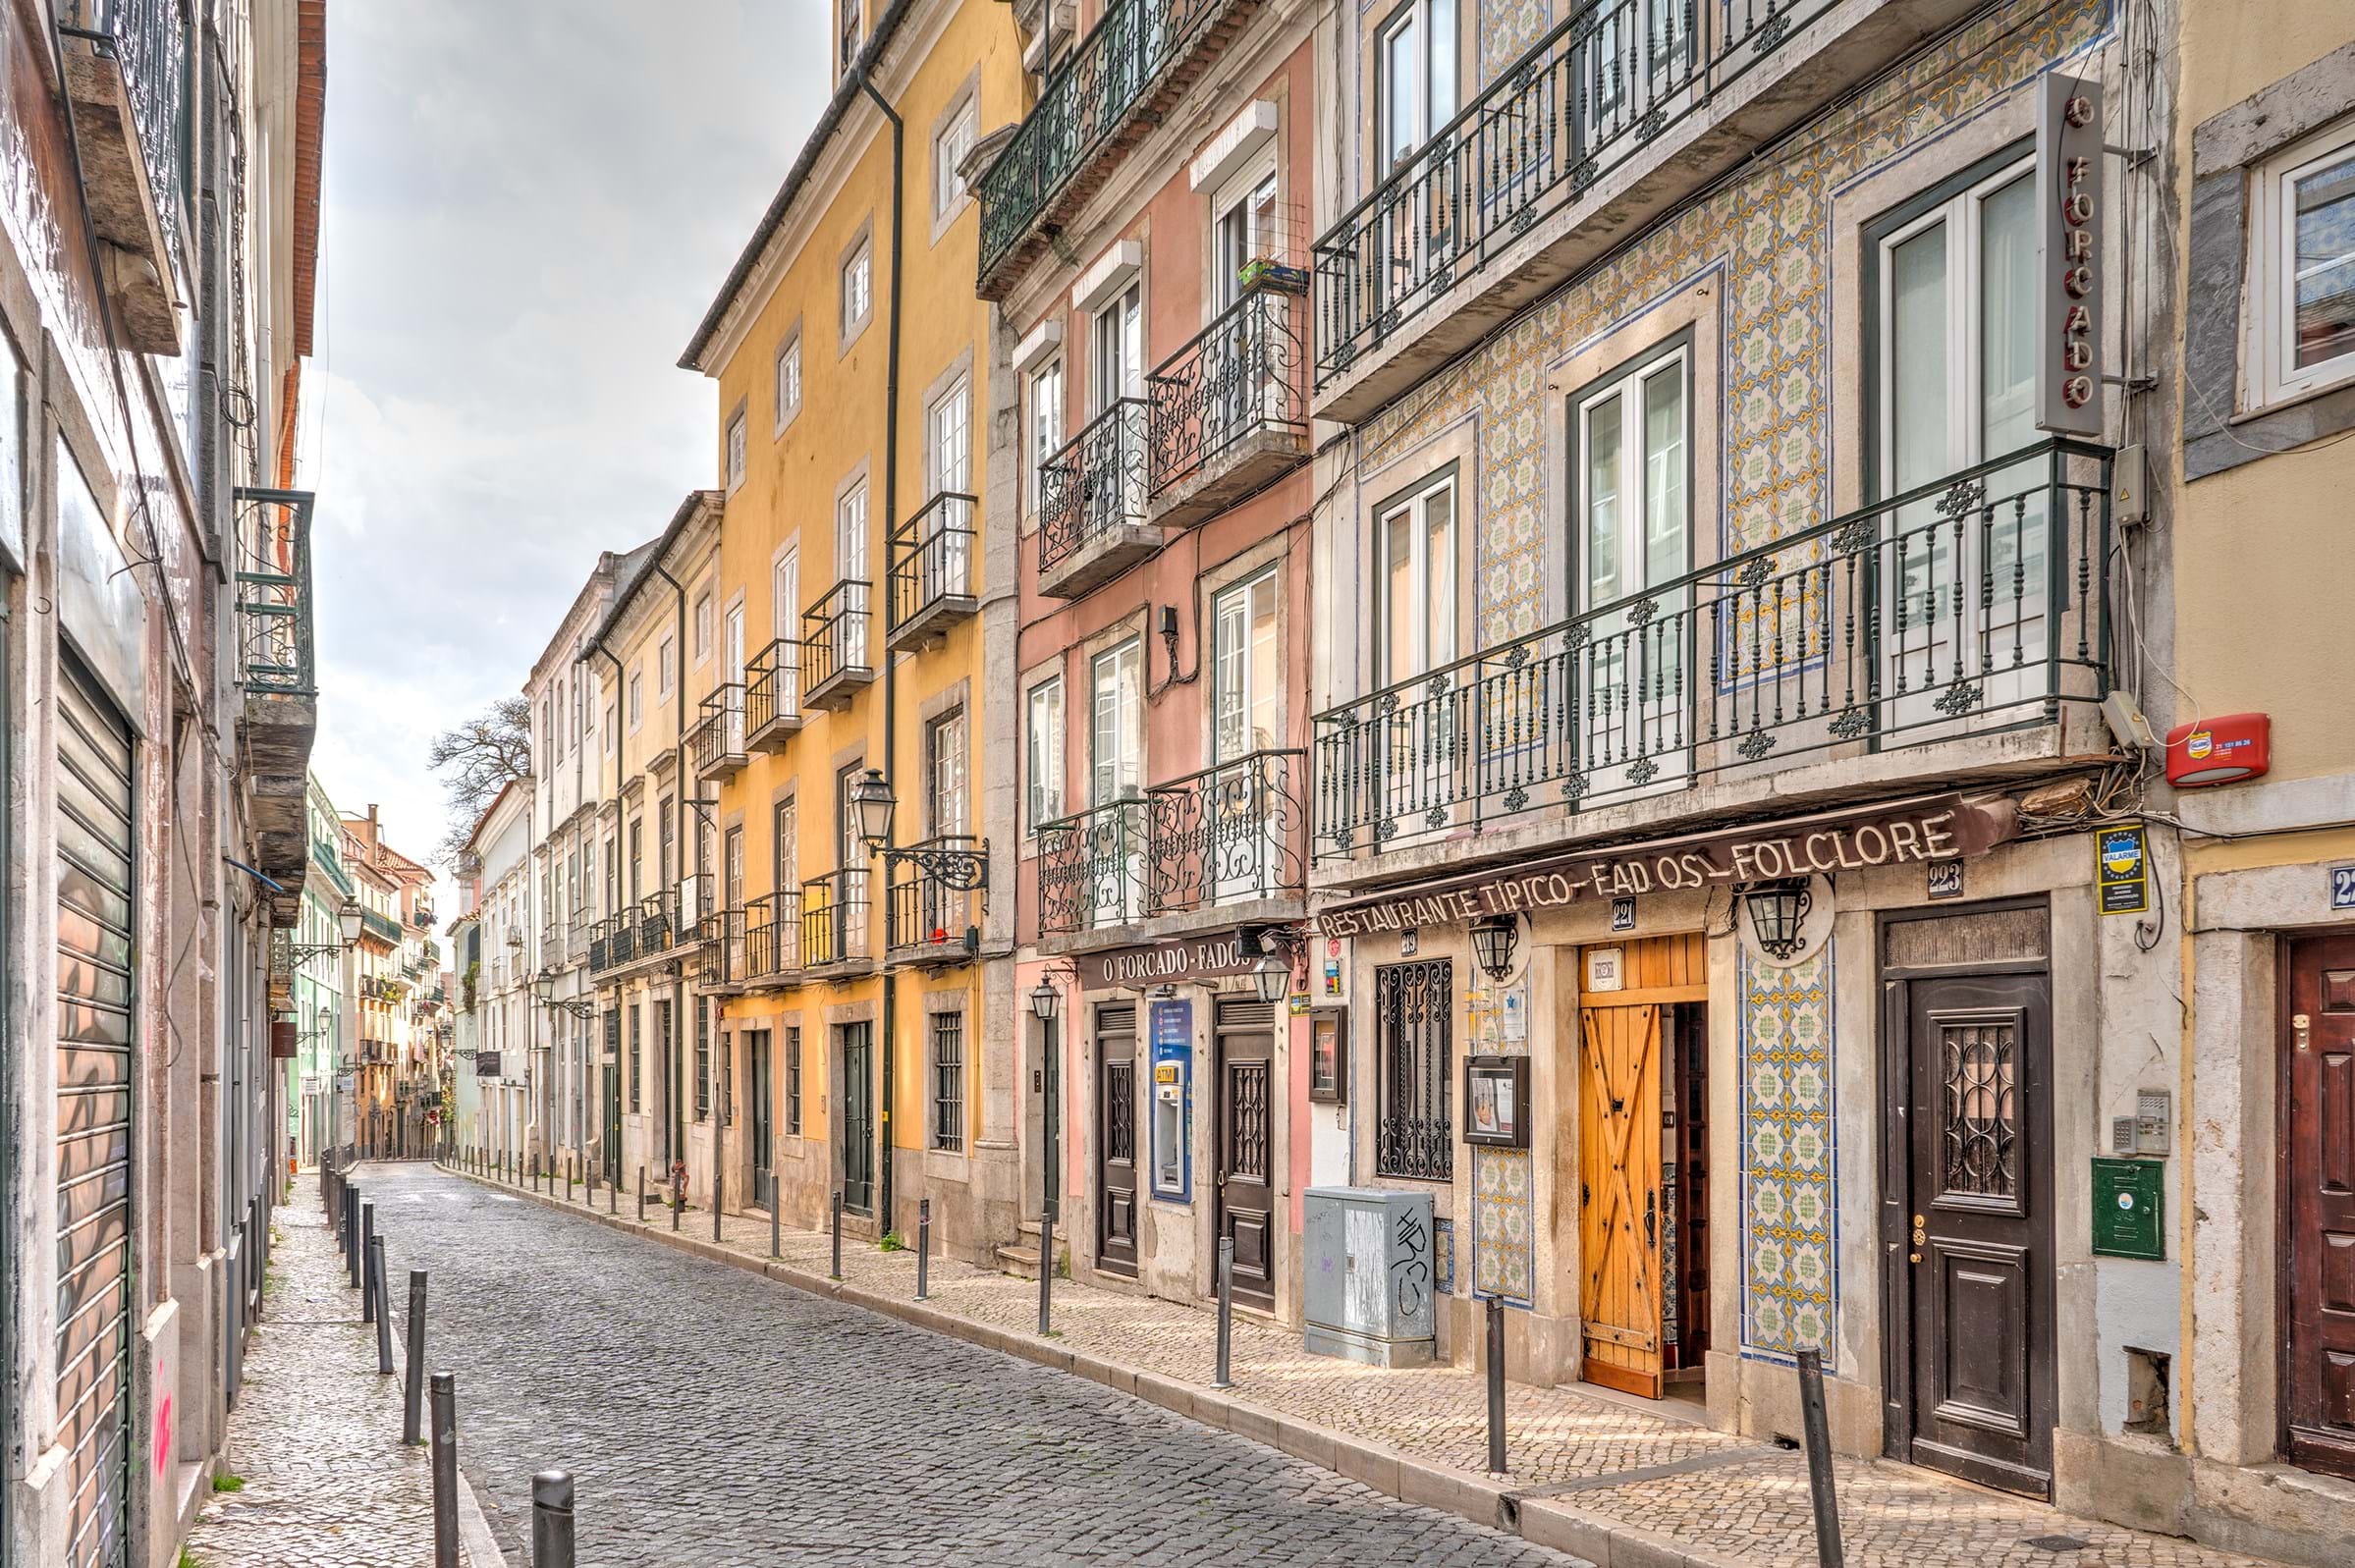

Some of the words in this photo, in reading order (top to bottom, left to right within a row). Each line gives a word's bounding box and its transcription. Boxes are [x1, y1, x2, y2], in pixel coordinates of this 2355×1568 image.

[2064, 96, 2095, 129] O
[2063, 156, 2095, 409] FORCADO
[2104, 849, 2139, 862] VALARME
[1320, 889, 1484, 939] RESTAURANTE
[1731, 809, 1960, 881] FOLCLORE
[1928, 863, 1961, 893] 223
[2335, 870, 2355, 904] 2
[1613, 902, 1632, 925] 221
[1401, 933, 1415, 952] 219
[1103, 959, 1114, 982] O
[1118, 947, 1188, 980] FORCADO
[1197, 940, 1251, 970] FADO
[1156, 1068, 1173, 1081] ATM
